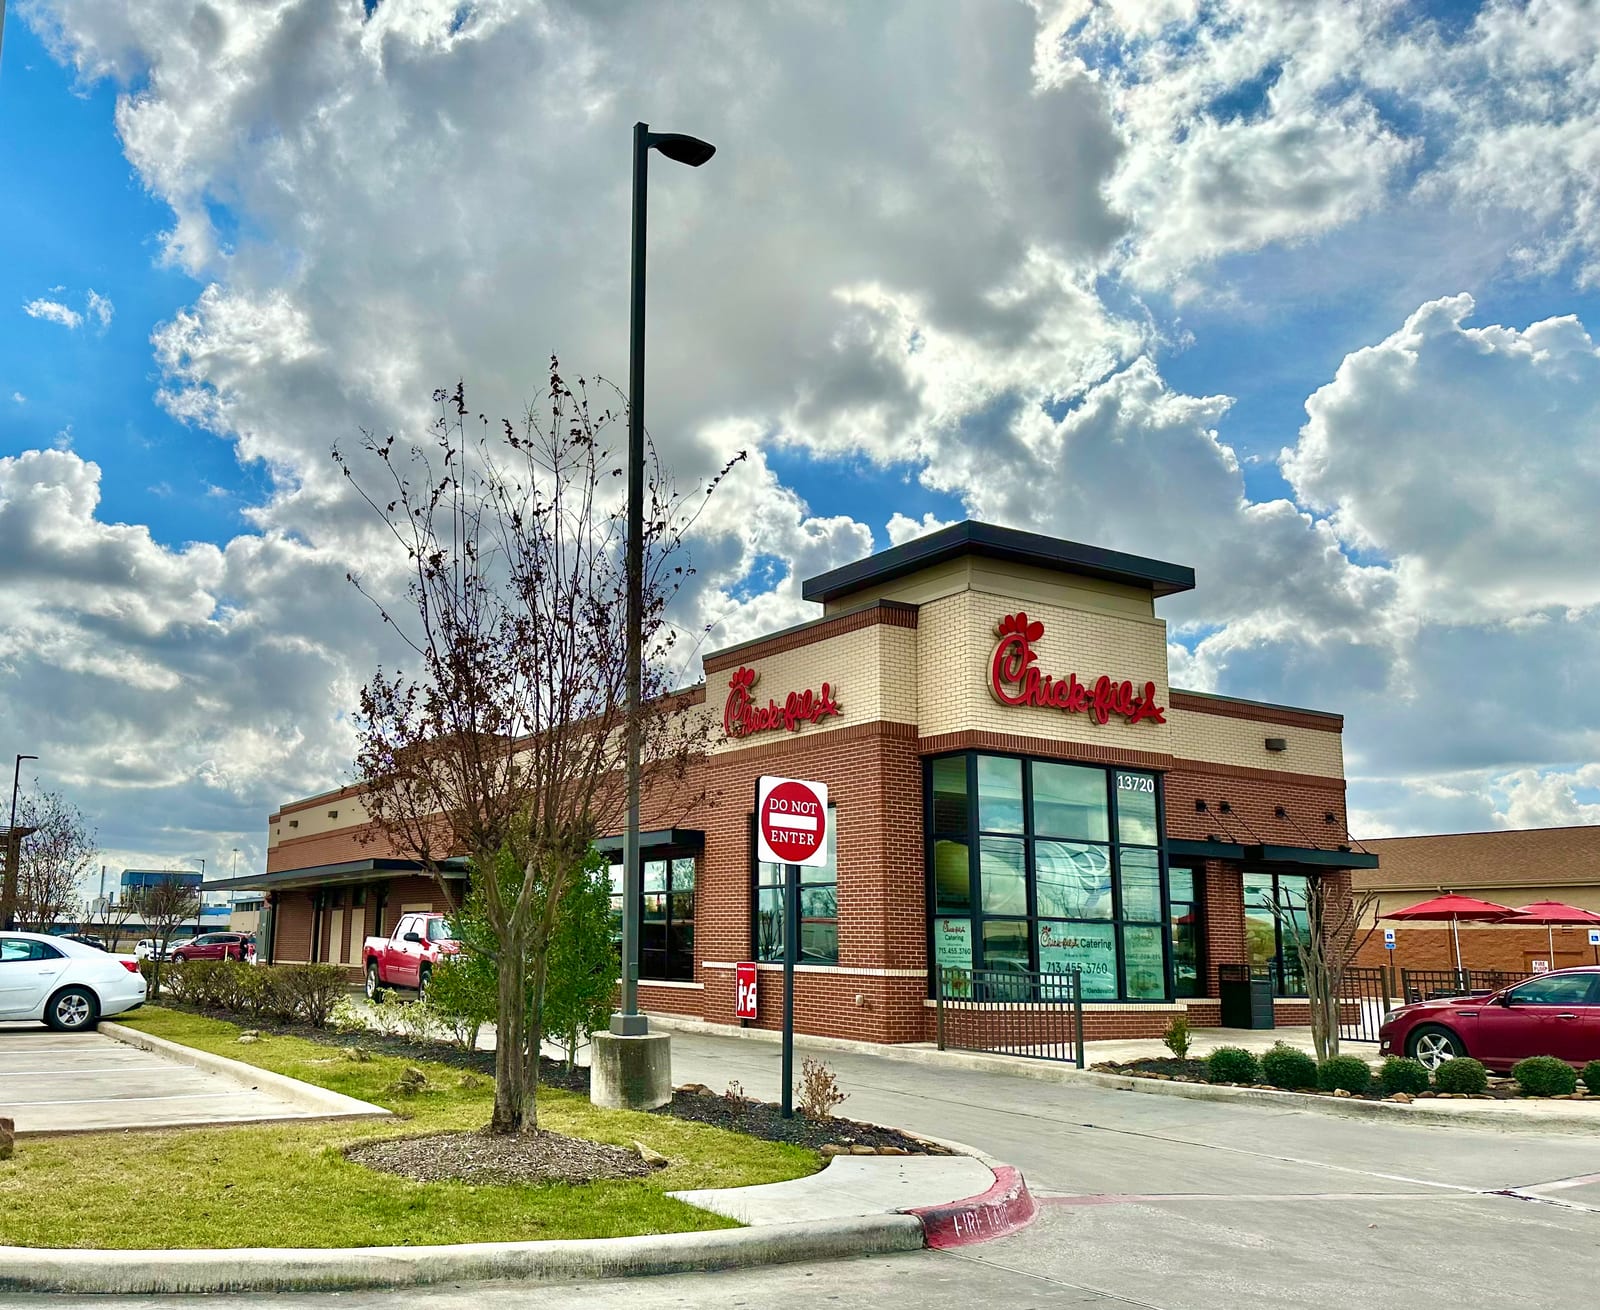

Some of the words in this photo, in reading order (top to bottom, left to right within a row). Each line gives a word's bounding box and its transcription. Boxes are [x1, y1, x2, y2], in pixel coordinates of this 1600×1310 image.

[991, 612, 1167, 725] Chick-fil-A
[1117, 775, 1155, 793] 13720
[769, 798, 788, 812] DO
[791, 800, 818, 815] NOT
[770, 830, 815, 846] ENTER
[1080, 938, 1112, 951] Catering
[1046, 961, 1108, 975] 713.455.3760
